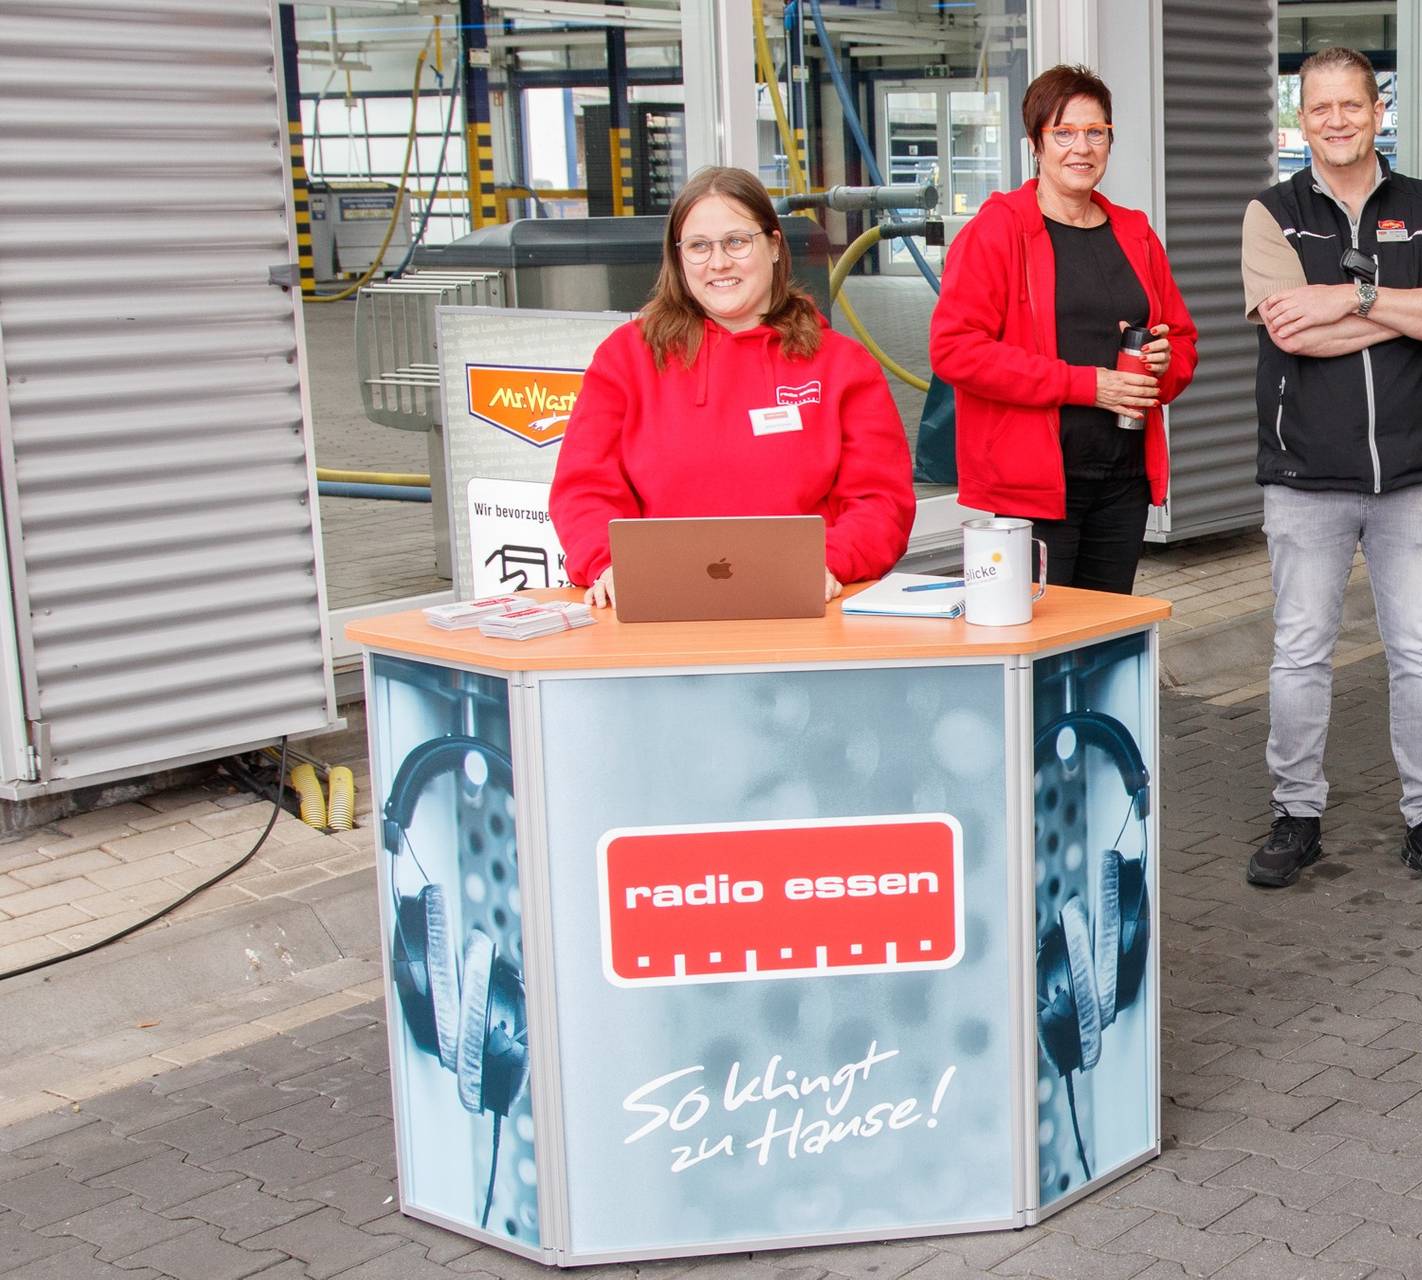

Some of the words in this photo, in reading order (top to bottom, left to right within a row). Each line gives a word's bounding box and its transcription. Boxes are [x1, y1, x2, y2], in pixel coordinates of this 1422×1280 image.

[474, 503, 491, 516] Wir
[625, 874, 764, 910] radio
[785, 870, 939, 901] essen
[623, 1065, 711, 1145] So
[723, 1040, 900, 1117] klingt
[671, 1132, 734, 1174] zu
[746, 1065, 957, 1166] Hause!
